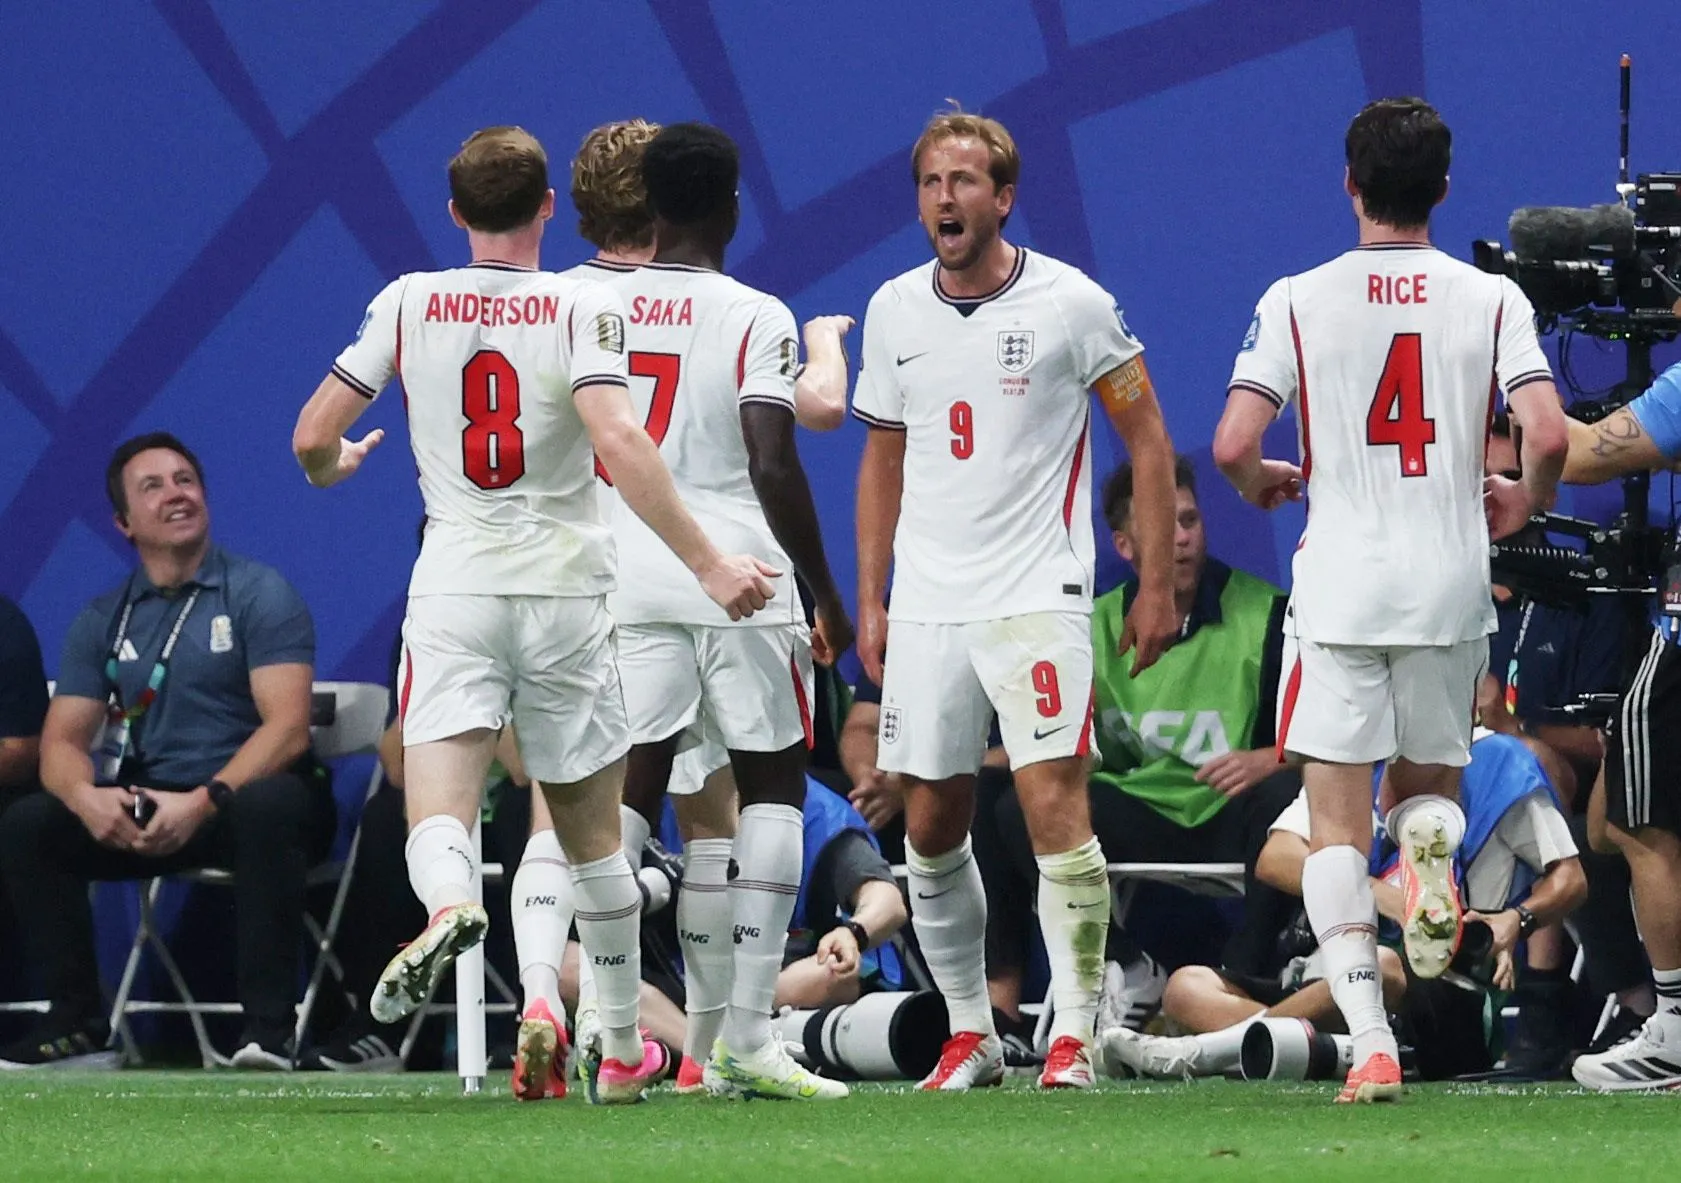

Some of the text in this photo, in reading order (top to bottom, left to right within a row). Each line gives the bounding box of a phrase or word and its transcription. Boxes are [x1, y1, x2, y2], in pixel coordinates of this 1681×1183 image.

[1368, 273, 1428, 305] RICE
[424, 292, 560, 328] ANDERSON
[629, 295, 692, 326] SAKA
[628, 350, 681, 449] 7
[1366, 332, 1436, 478] 4
[462, 349, 526, 491] 8
[949, 400, 974, 460] 9
[1031, 660, 1062, 718] 9
[525, 895, 557, 908] ENG
[680, 928, 711, 945] ENG
[733, 923, 761, 939] ENG
[594, 954, 626, 966] ENG
[1347, 970, 1376, 984] ENG
